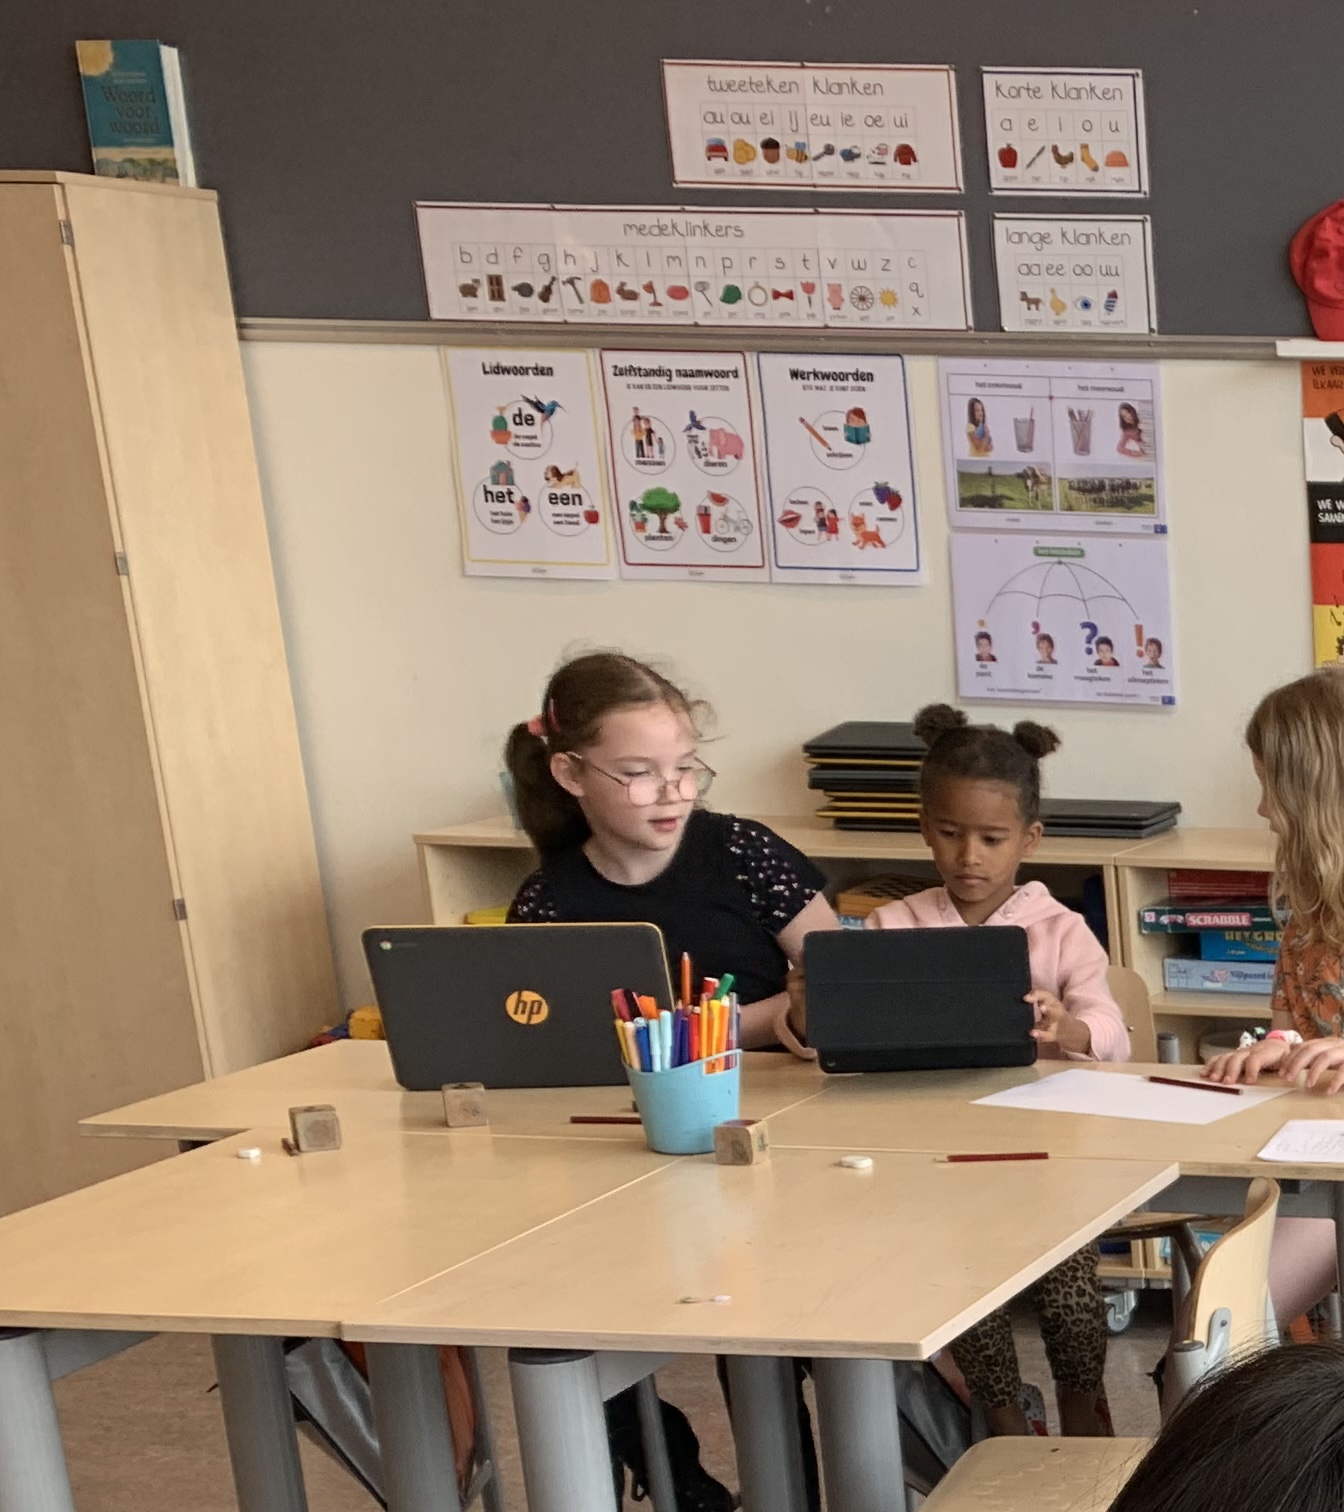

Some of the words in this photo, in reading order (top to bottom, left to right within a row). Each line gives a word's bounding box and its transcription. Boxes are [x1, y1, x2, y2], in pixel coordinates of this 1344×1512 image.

[810, 114, 832, 127] eu
[481, 362, 554, 377] Lidwoorden
[612, 364, 672, 382] Zelfstandig
[675, 366, 739, 379] naamwoord
[789, 367, 874, 382] Werkwoorden
[1312, 365, 1328, 376] WE
[1312, 379, 1344, 390] ELKAAR
[512, 407, 535, 427] de
[483, 484, 515, 504] het
[549, 492, 583, 506] een
[1317, 499, 1332, 511] WE
[1188, 914, 1249, 926] SCRABBLE
[513, 990, 542, 1024] hp
